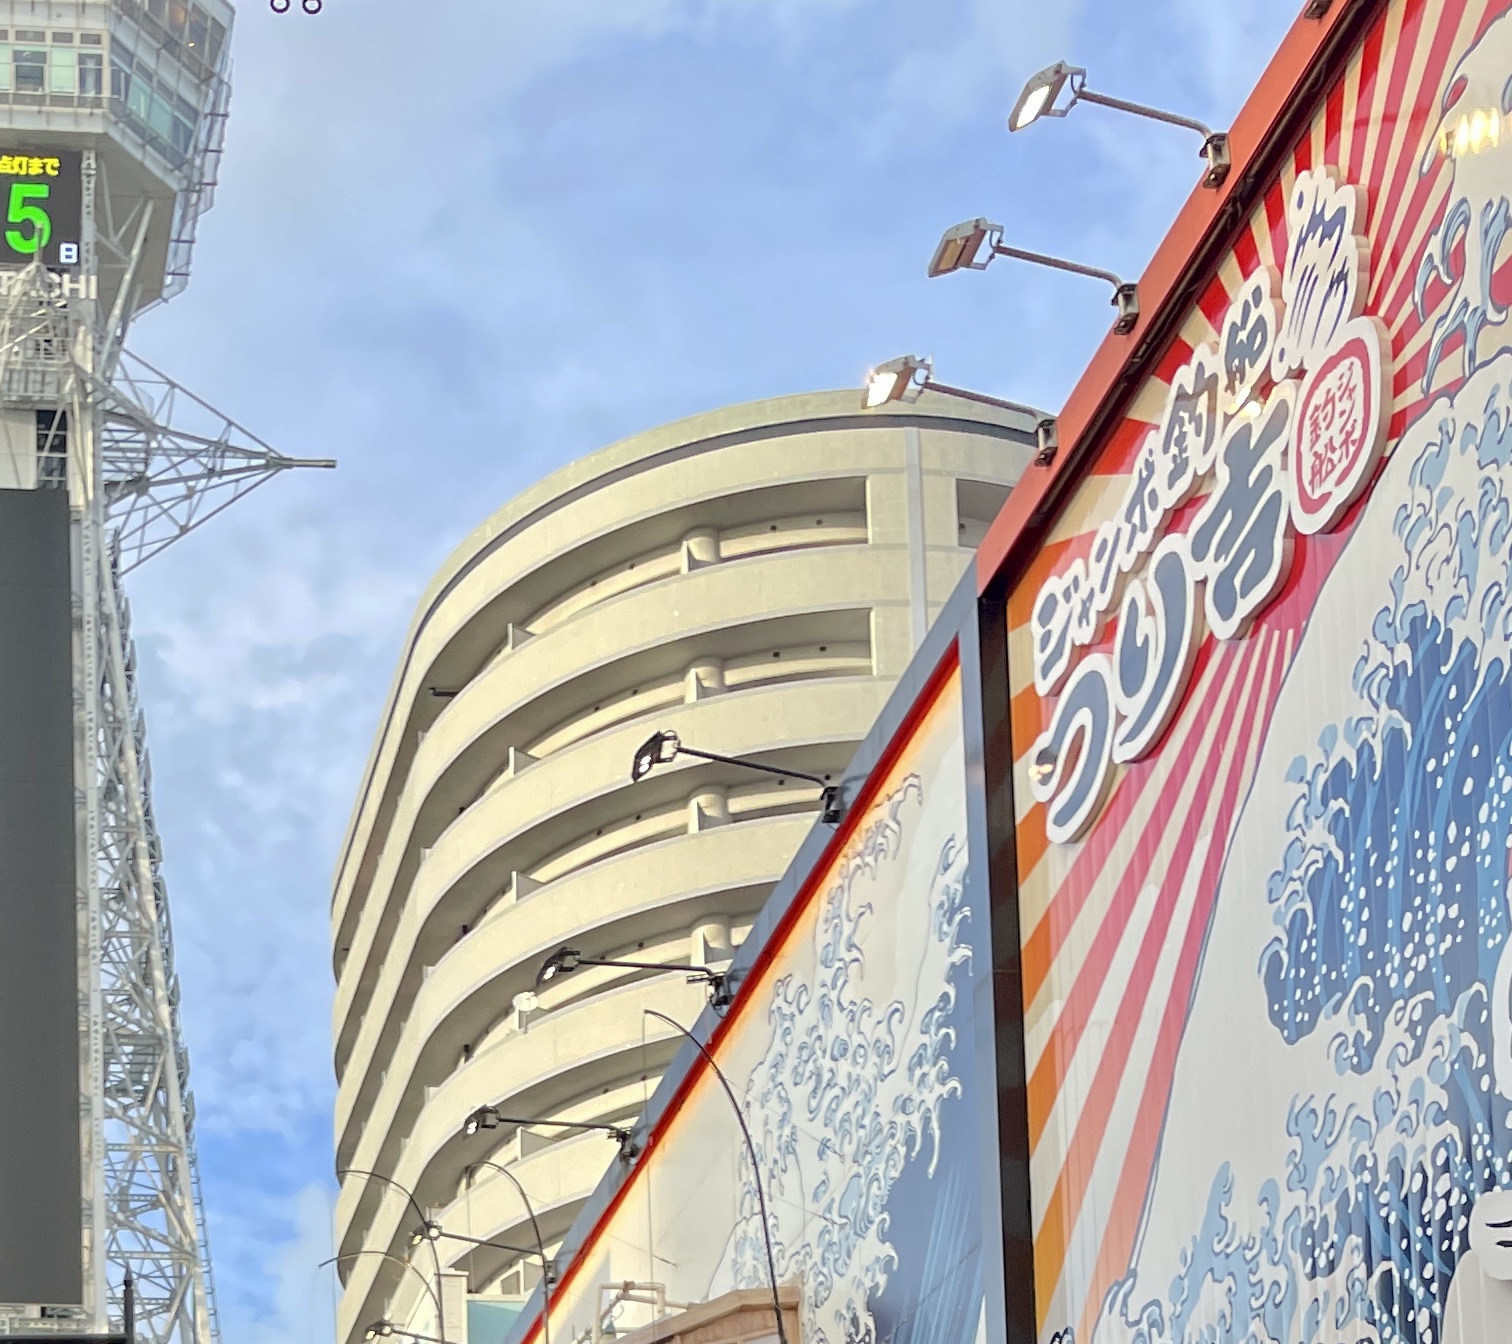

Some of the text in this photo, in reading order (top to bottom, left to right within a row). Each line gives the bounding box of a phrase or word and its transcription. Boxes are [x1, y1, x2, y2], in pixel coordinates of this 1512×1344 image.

[5, 183, 52, 254] 5
[1308, 388, 1338, 496] 釣船
[1336, 361, 1358, 464] ジャンボ
[1038, 285, 1264, 684] ジャンボ釣船
[1033, 396, 1289, 838] つり吉
